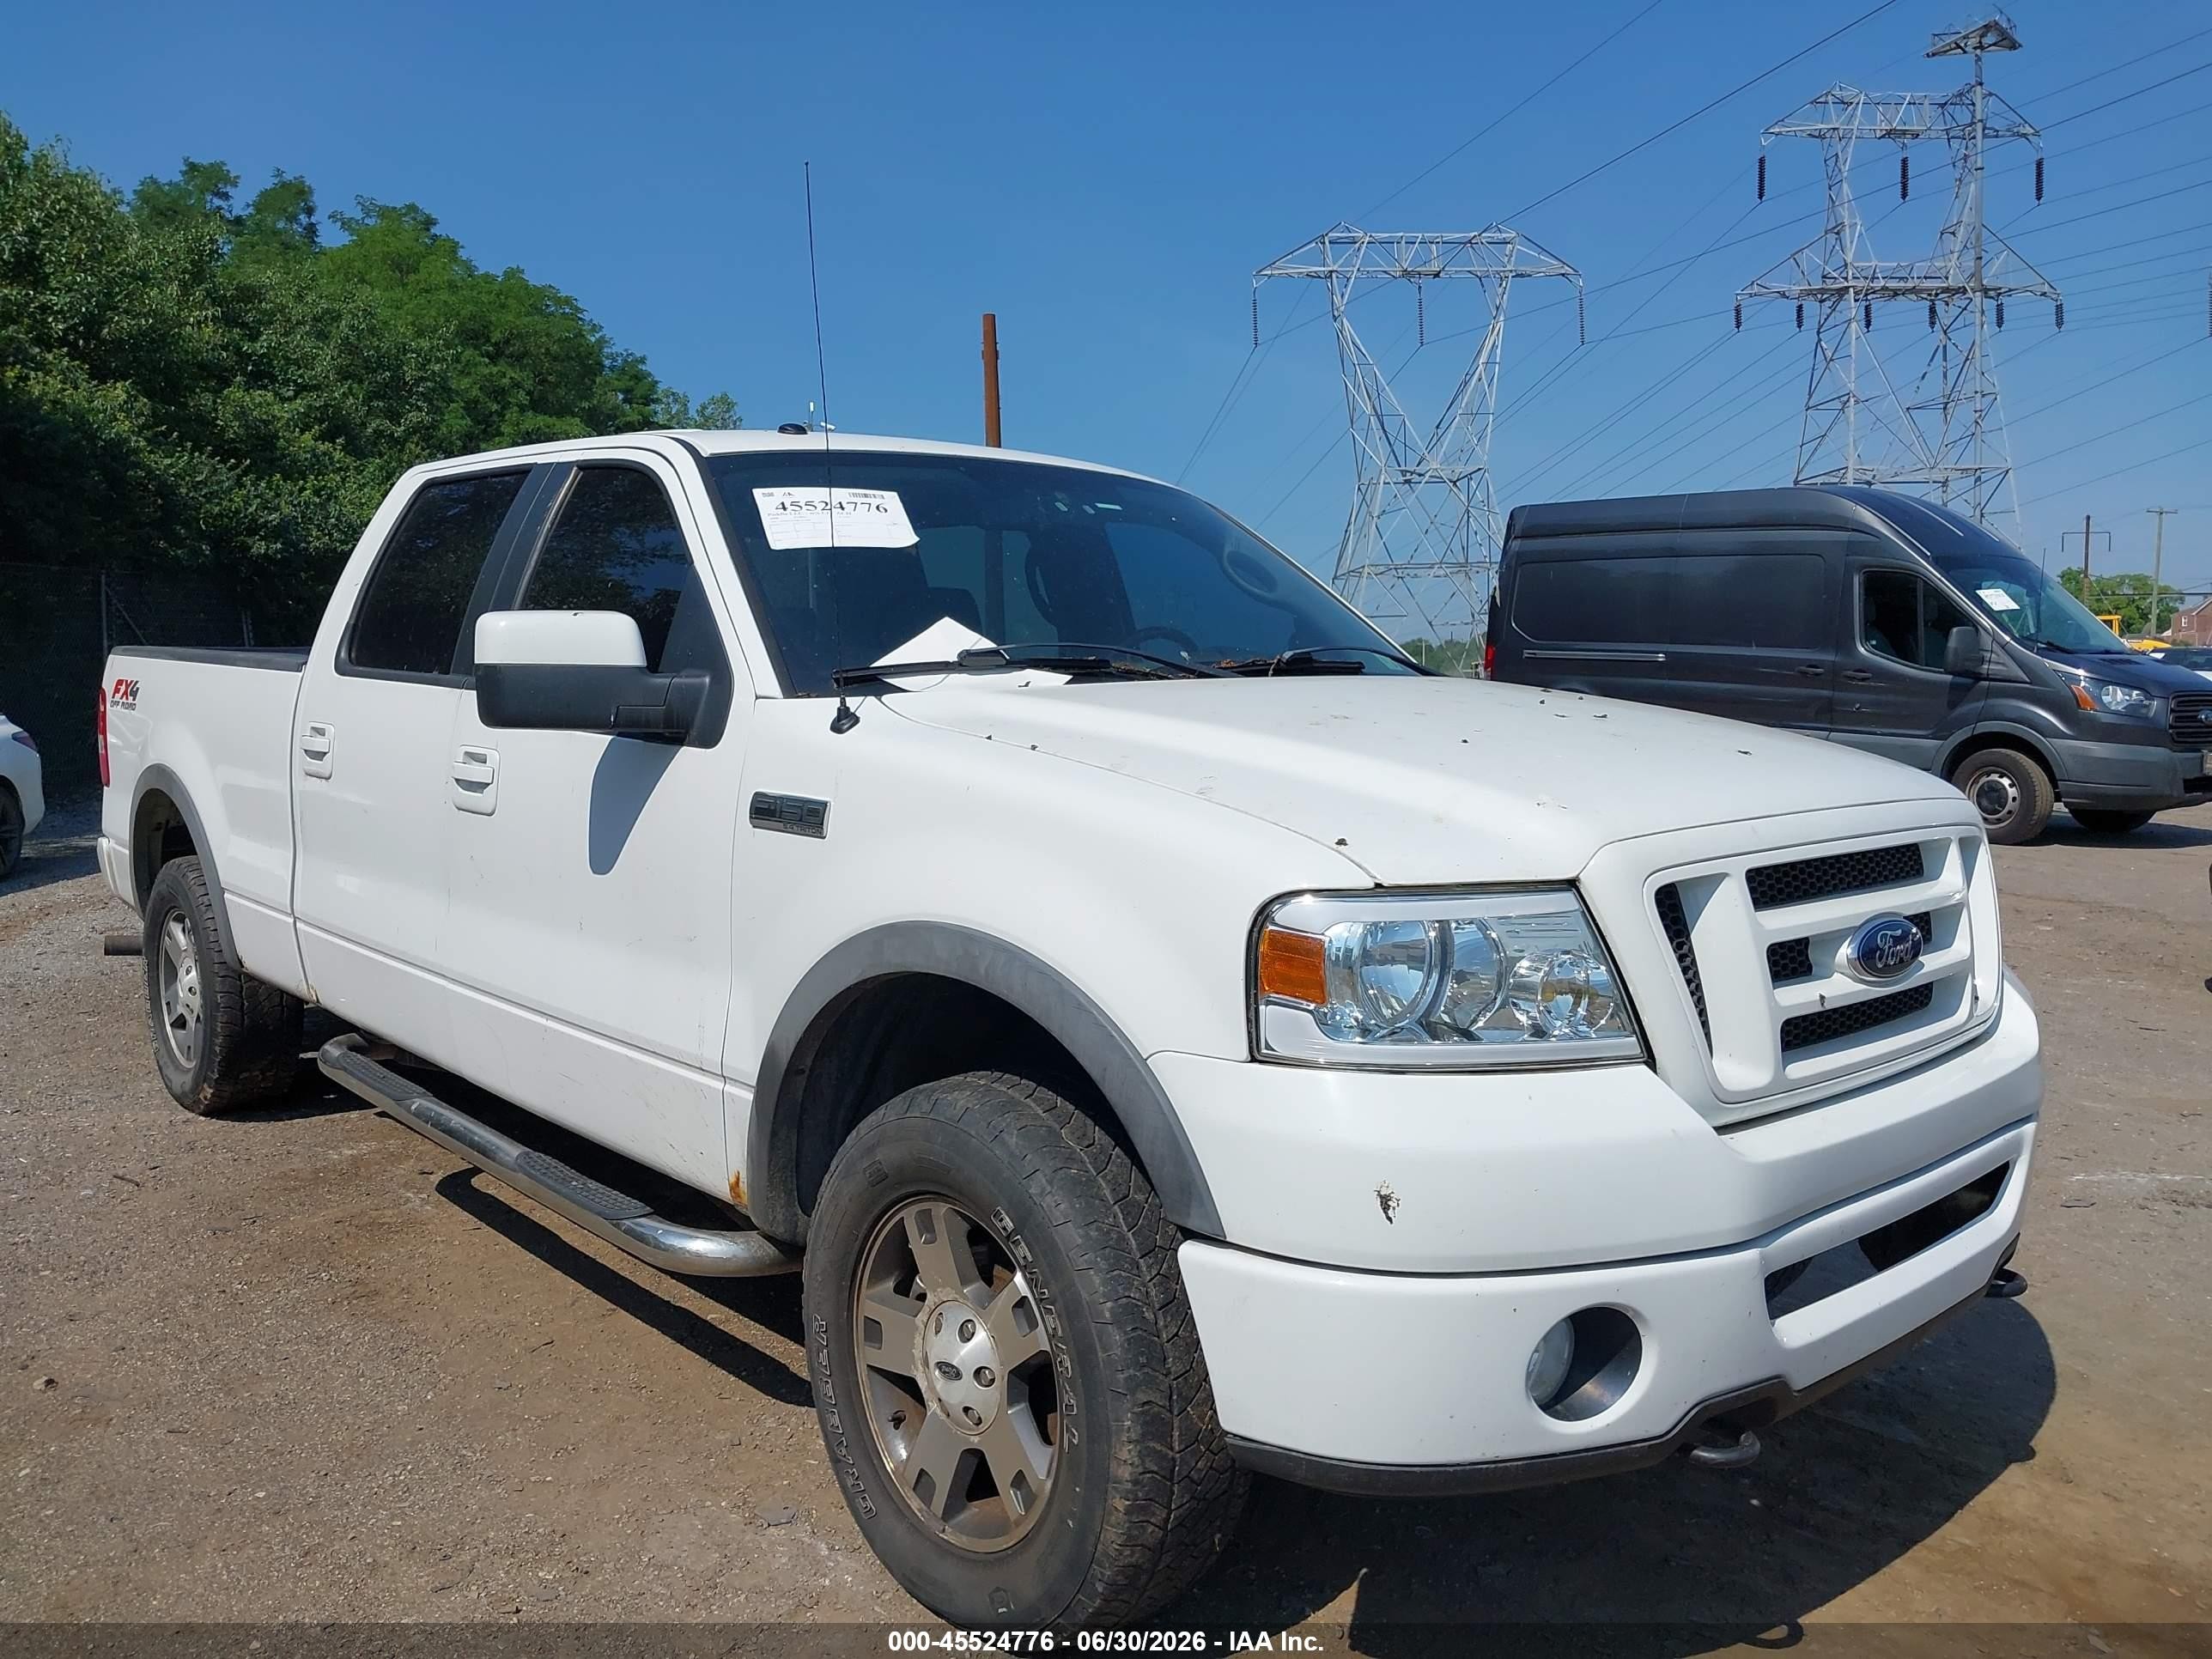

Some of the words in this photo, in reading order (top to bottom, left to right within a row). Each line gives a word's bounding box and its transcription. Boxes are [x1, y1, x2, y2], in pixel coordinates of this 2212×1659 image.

[775, 501, 888, 514] 45524776
[112, 679, 139, 701] FX4
[120, 702, 137, 710] ROAD
[1875, 929, 1913, 968] Ford
[991, 1206, 1079, 1455] GENERAL
[811, 1312, 877, 1520] GRABBER
